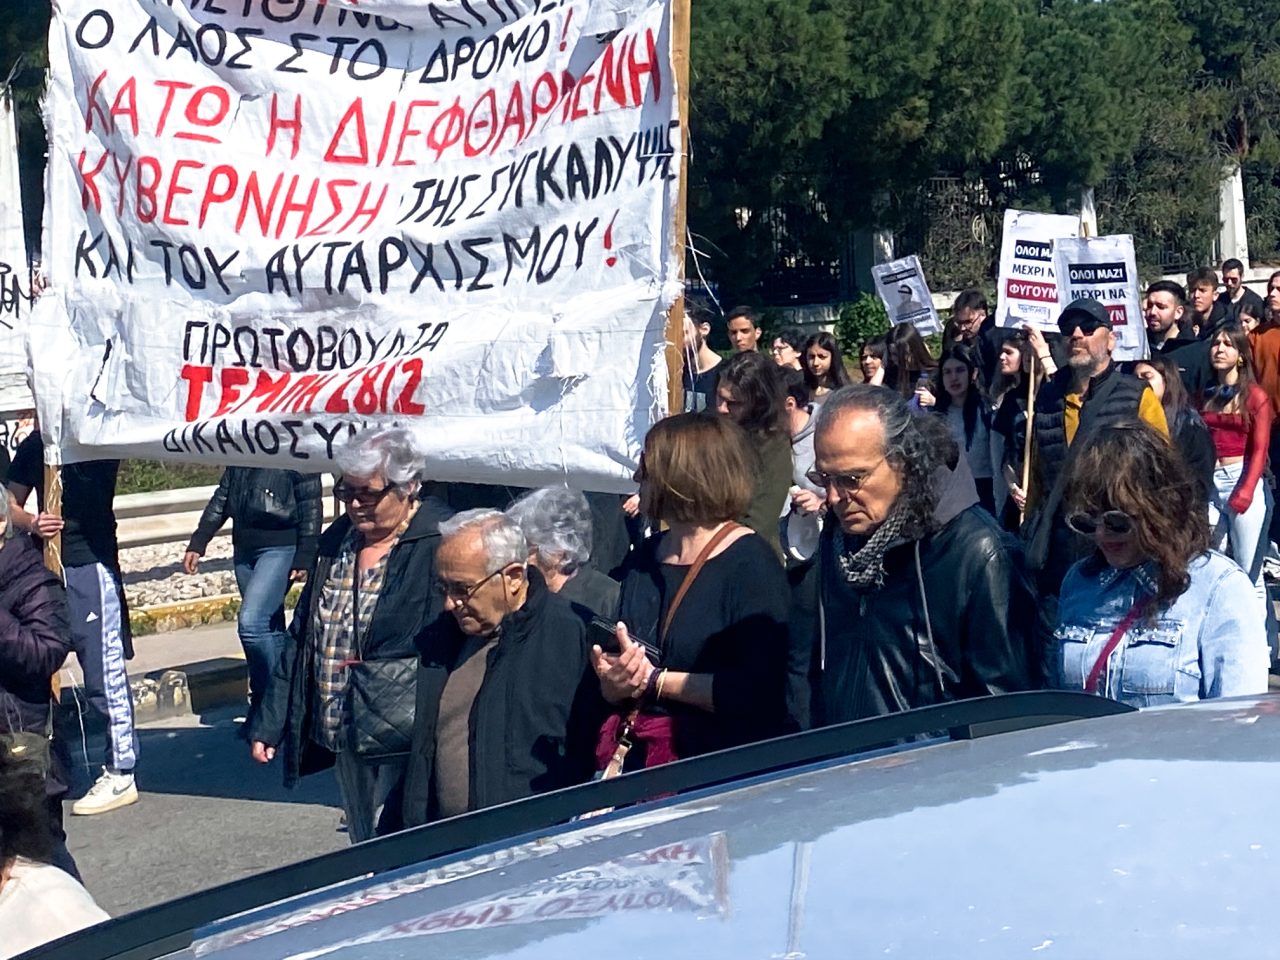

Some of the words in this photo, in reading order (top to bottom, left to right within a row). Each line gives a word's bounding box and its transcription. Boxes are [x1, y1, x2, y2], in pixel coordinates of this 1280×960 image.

[76, 9, 114, 49] Ο
[128, 16, 265, 70] ΛΑΟΣ
[276, 33, 389, 81] ΣΤΟ
[266, 92, 302, 160] Η
[77, 148, 389, 240] ΚΥΒΕΡΝΗΣΗ
[397, 173, 481, 228] ΤΗΣ
[74, 230, 135, 284] ΚΑΙ
[149, 240, 240, 295] ΤΟΥ
[1012, 263, 1045, 278] ΜΕΧΡΙ
[1015, 244, 1039, 257] ΟΛΟΙ
[1008, 283, 1058, 299] ΦΥΓΟΥΝ
[1069, 268, 1095, 281] ΟΛΟΙ
[1097, 268, 1124, 280] ΜΑΖΙ
[1071, 289, 1106, 300] ΜΕΧΡΙ
[1109, 288, 1127, 300] ΝΑ
[182, 320, 450, 372] ΠΡΩΤΟΒΟΥΛΙΑ
[162, 418, 399, 459] ΔΙΚΑΙΟΣΥ
